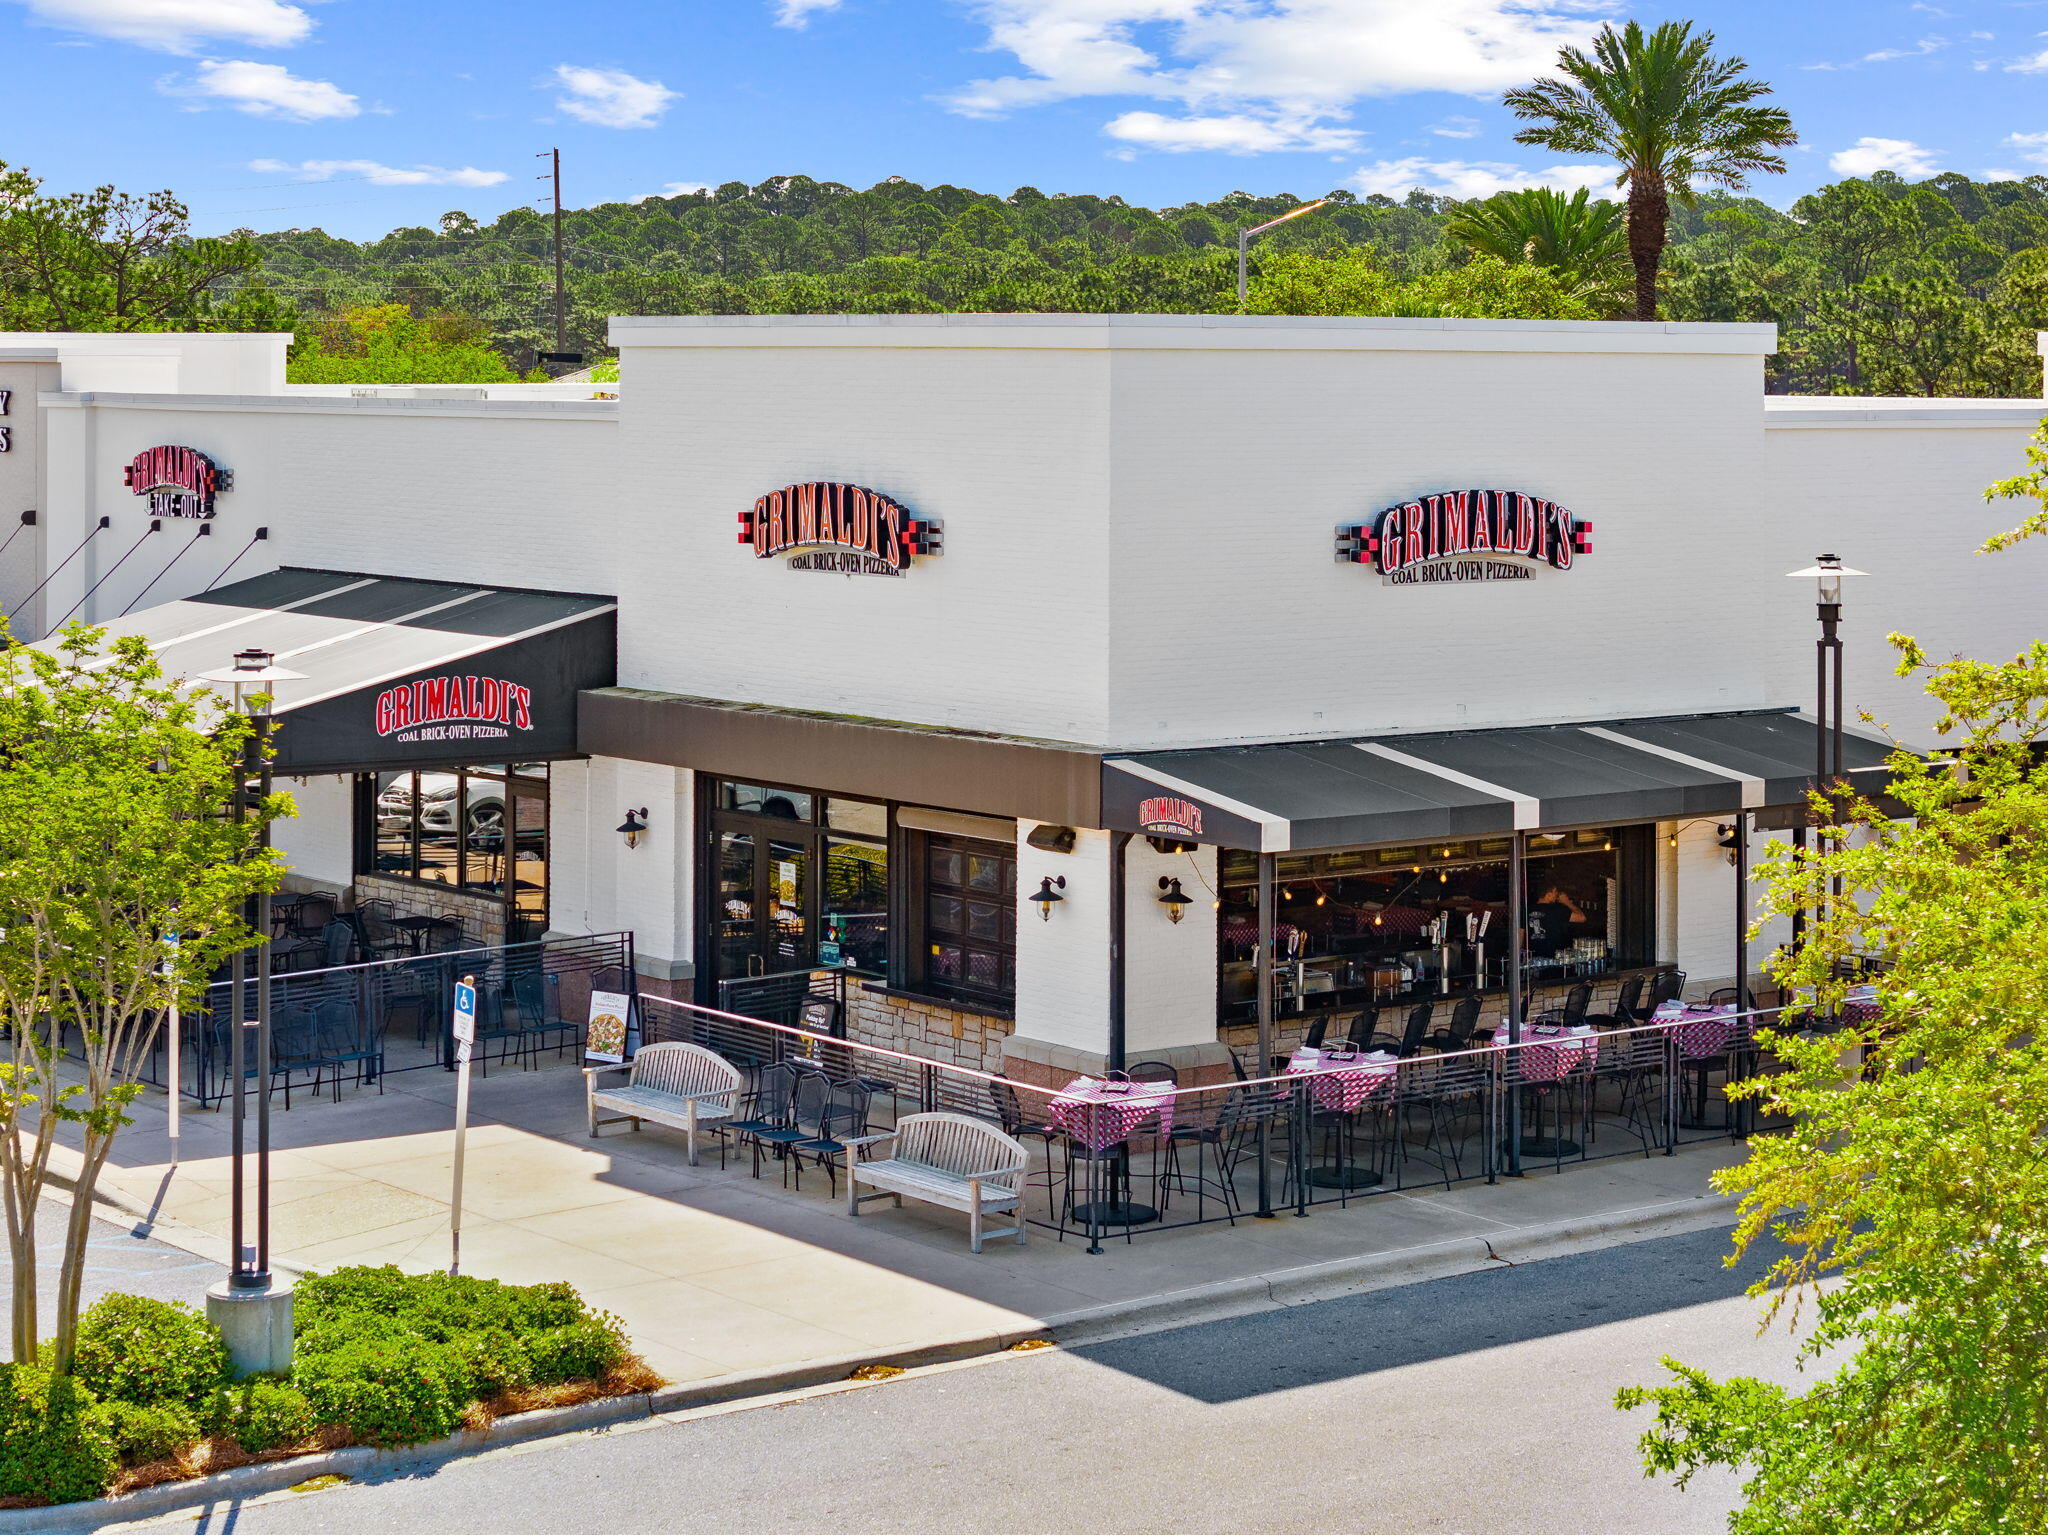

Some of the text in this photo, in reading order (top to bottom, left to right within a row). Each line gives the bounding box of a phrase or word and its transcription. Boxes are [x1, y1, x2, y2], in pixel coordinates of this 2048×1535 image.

[132, 445, 208, 501] GRIMALDI'S
[154, 494, 199, 519] TAKE-OUT
[753, 483, 901, 569] GRIMALDI'S
[1380, 489, 1574, 575] GRIMALDI'S
[792, 552, 900, 577] COAL BRICK-OVEN PIZZERIA
[1391, 560, 1530, 585] COAL BRICK-OVEN PIZZERIA
[375, 675, 531, 737] GRIMALDI'S
[397, 725, 509, 743] COAL BRICK-OVEN PIZZERIA
[1140, 797, 1202, 833] GRIMALDI'S
